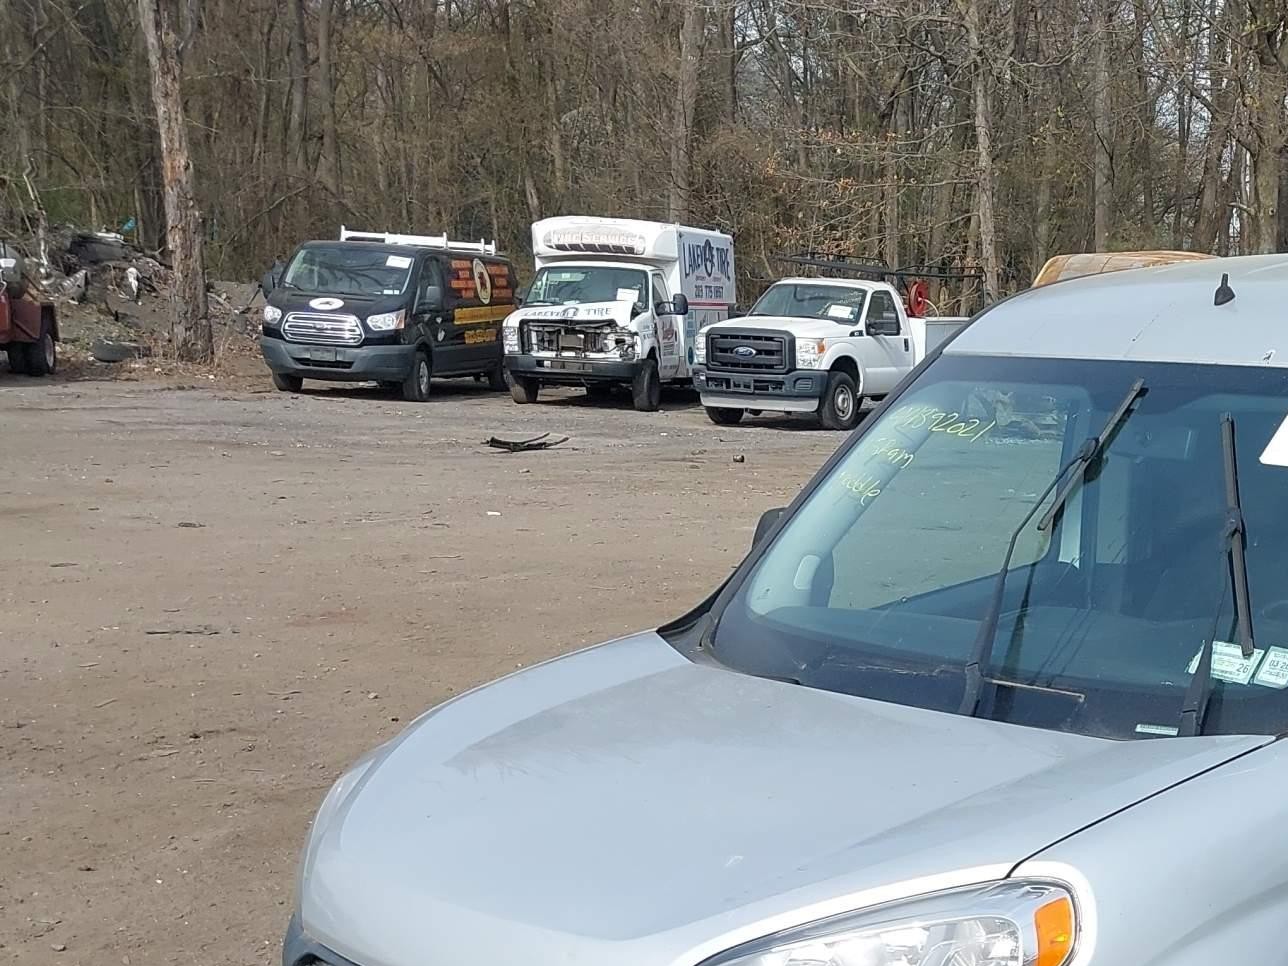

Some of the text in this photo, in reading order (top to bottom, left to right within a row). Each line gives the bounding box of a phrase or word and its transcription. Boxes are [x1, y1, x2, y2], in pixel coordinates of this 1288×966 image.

[716, 247, 731, 281] TIRE
[584, 307, 613, 317] TIRE
[1236, 663, 1250, 674] 26
